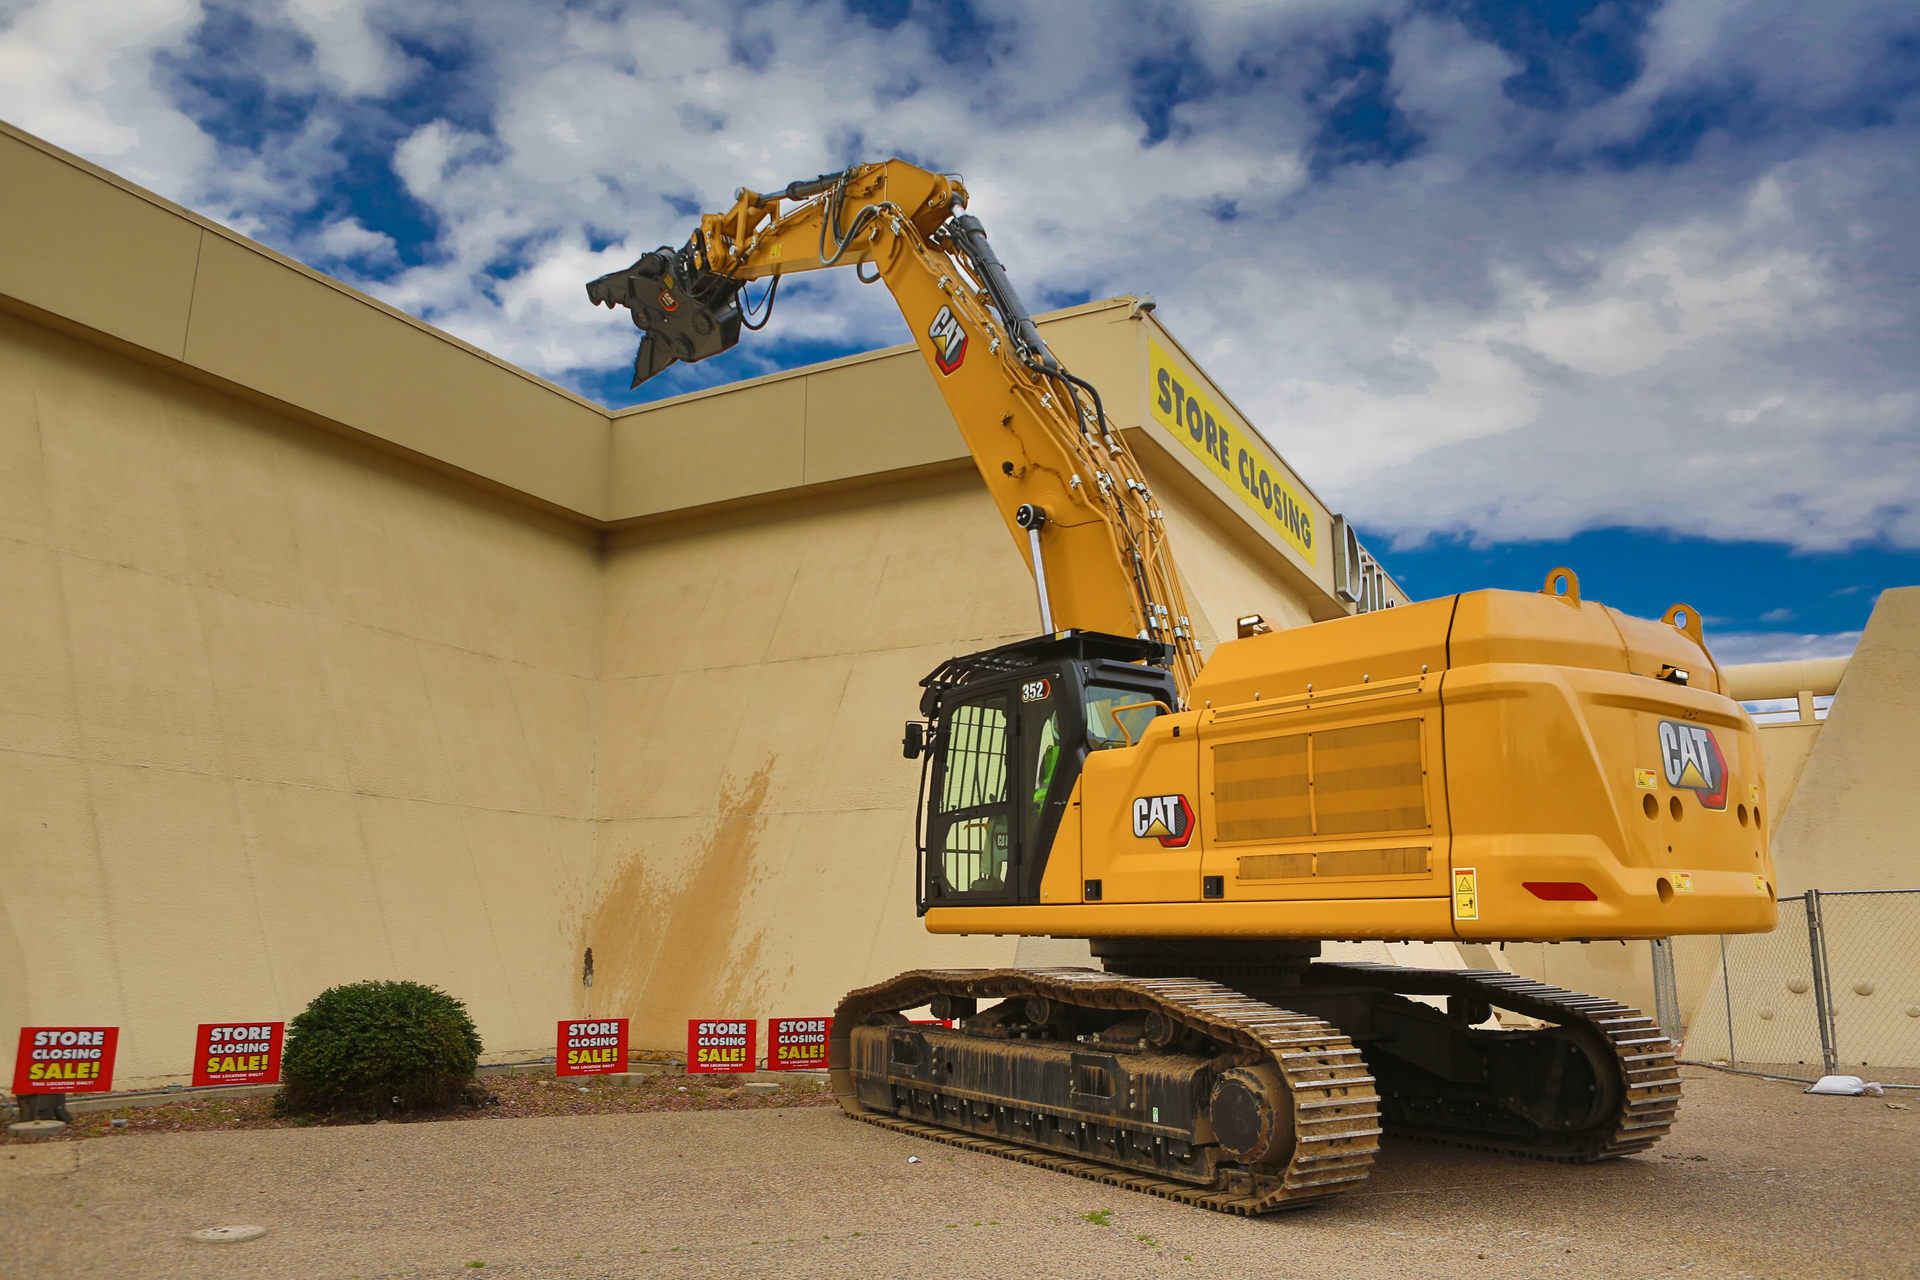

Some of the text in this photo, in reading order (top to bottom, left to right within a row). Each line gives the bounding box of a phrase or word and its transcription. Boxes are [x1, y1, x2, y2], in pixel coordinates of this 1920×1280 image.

[929, 305, 966, 361] CAT
[1157, 367, 1311, 549] STORE CLOSING
[1022, 681, 1044, 700] 352
[1659, 721, 1714, 789] CAT
[1133, 795, 1179, 837] CAT
[209, 1026, 272, 1042] STORE
[568, 1022, 619, 1037] STORE
[698, 1022, 747, 1035] STORE
[778, 1020, 826, 1033] STORE
[33, 1030, 105, 1046] STORE
[567, 1036, 619, 1048] CLOSING
[697, 1037, 747, 1046] CLOSING
[778, 1034, 825, 1044] CLOSING
[31, 1048, 102, 1060] CLOSING
[208, 1042, 270, 1055] CLOSING
[567, 1047, 618, 1065] SALE!
[697, 1047, 746, 1063] SALE!
[777, 1044, 825, 1060] SALE!
[28, 1061, 101, 1080] SALE!
[206, 1054, 269, 1073] SALE!
